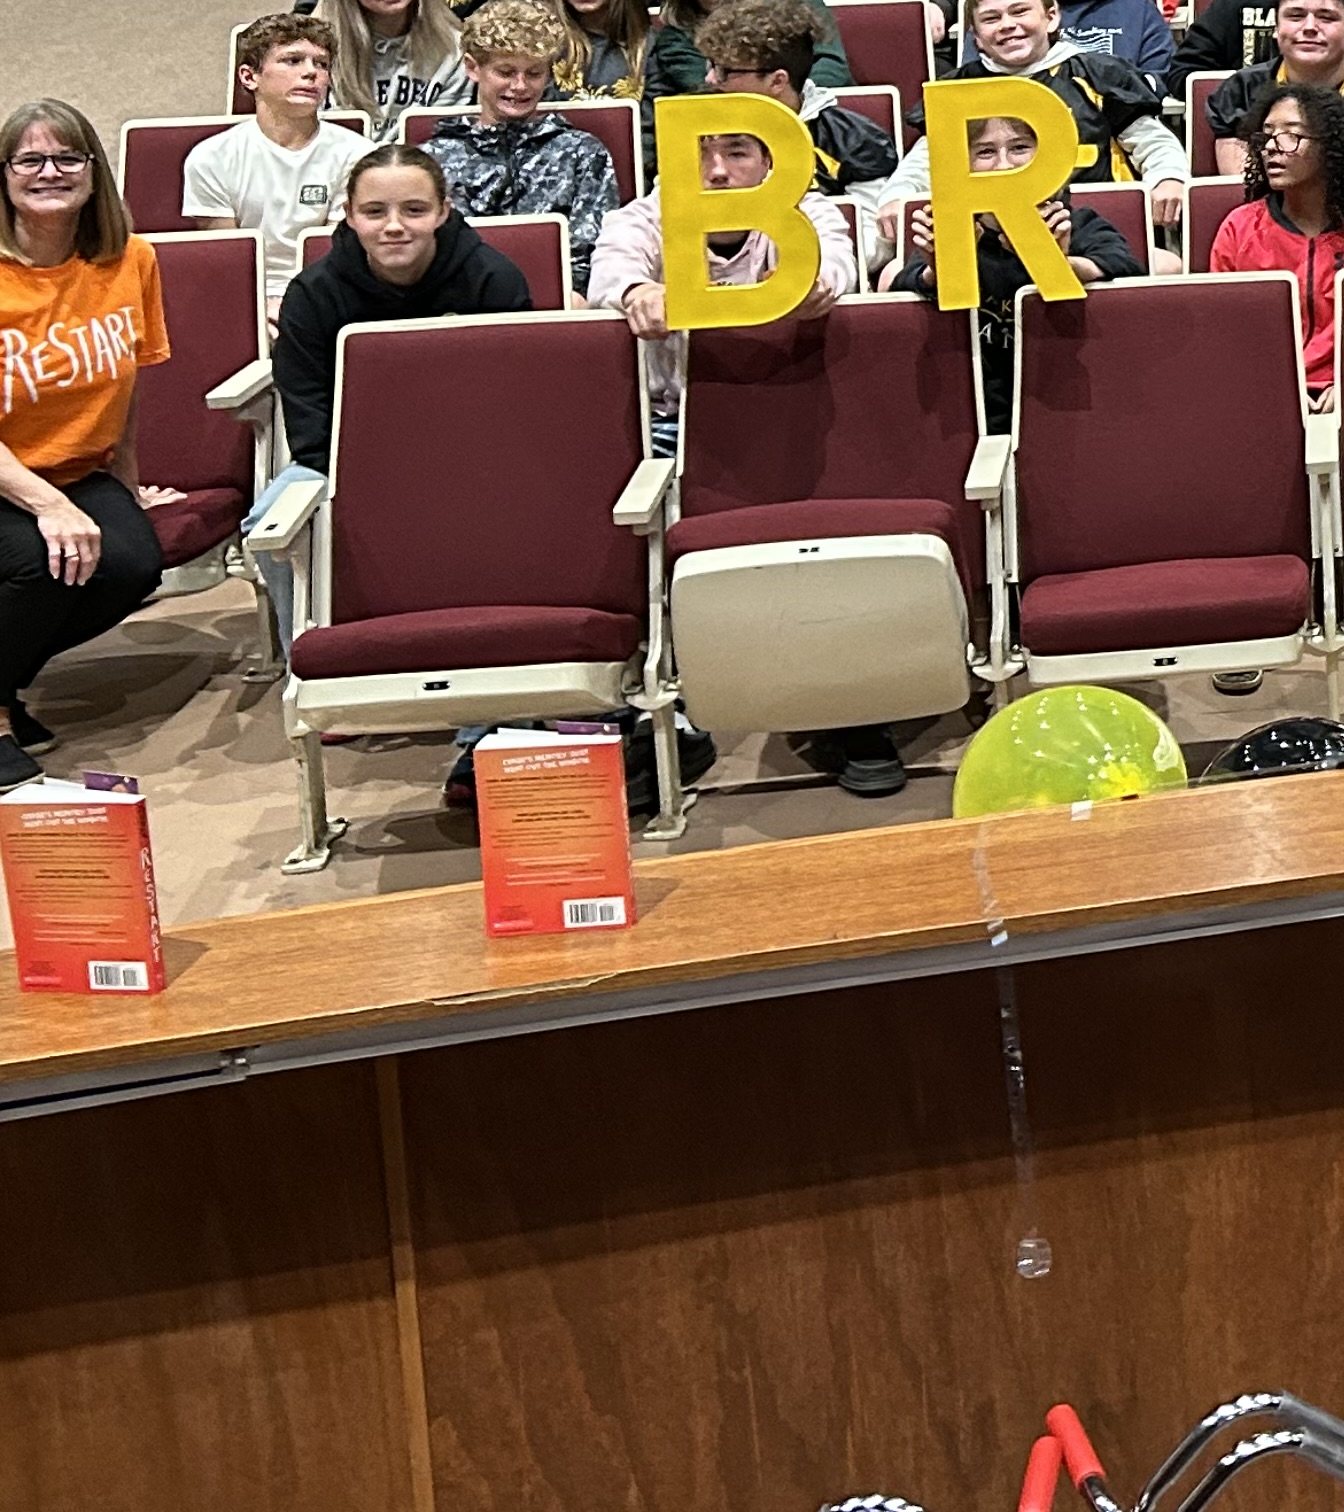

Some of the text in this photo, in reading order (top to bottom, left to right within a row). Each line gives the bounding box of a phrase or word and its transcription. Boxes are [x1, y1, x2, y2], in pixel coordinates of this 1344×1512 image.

[653, 76, 1087, 332] B R
[0, 306, 137, 414] RESTART
